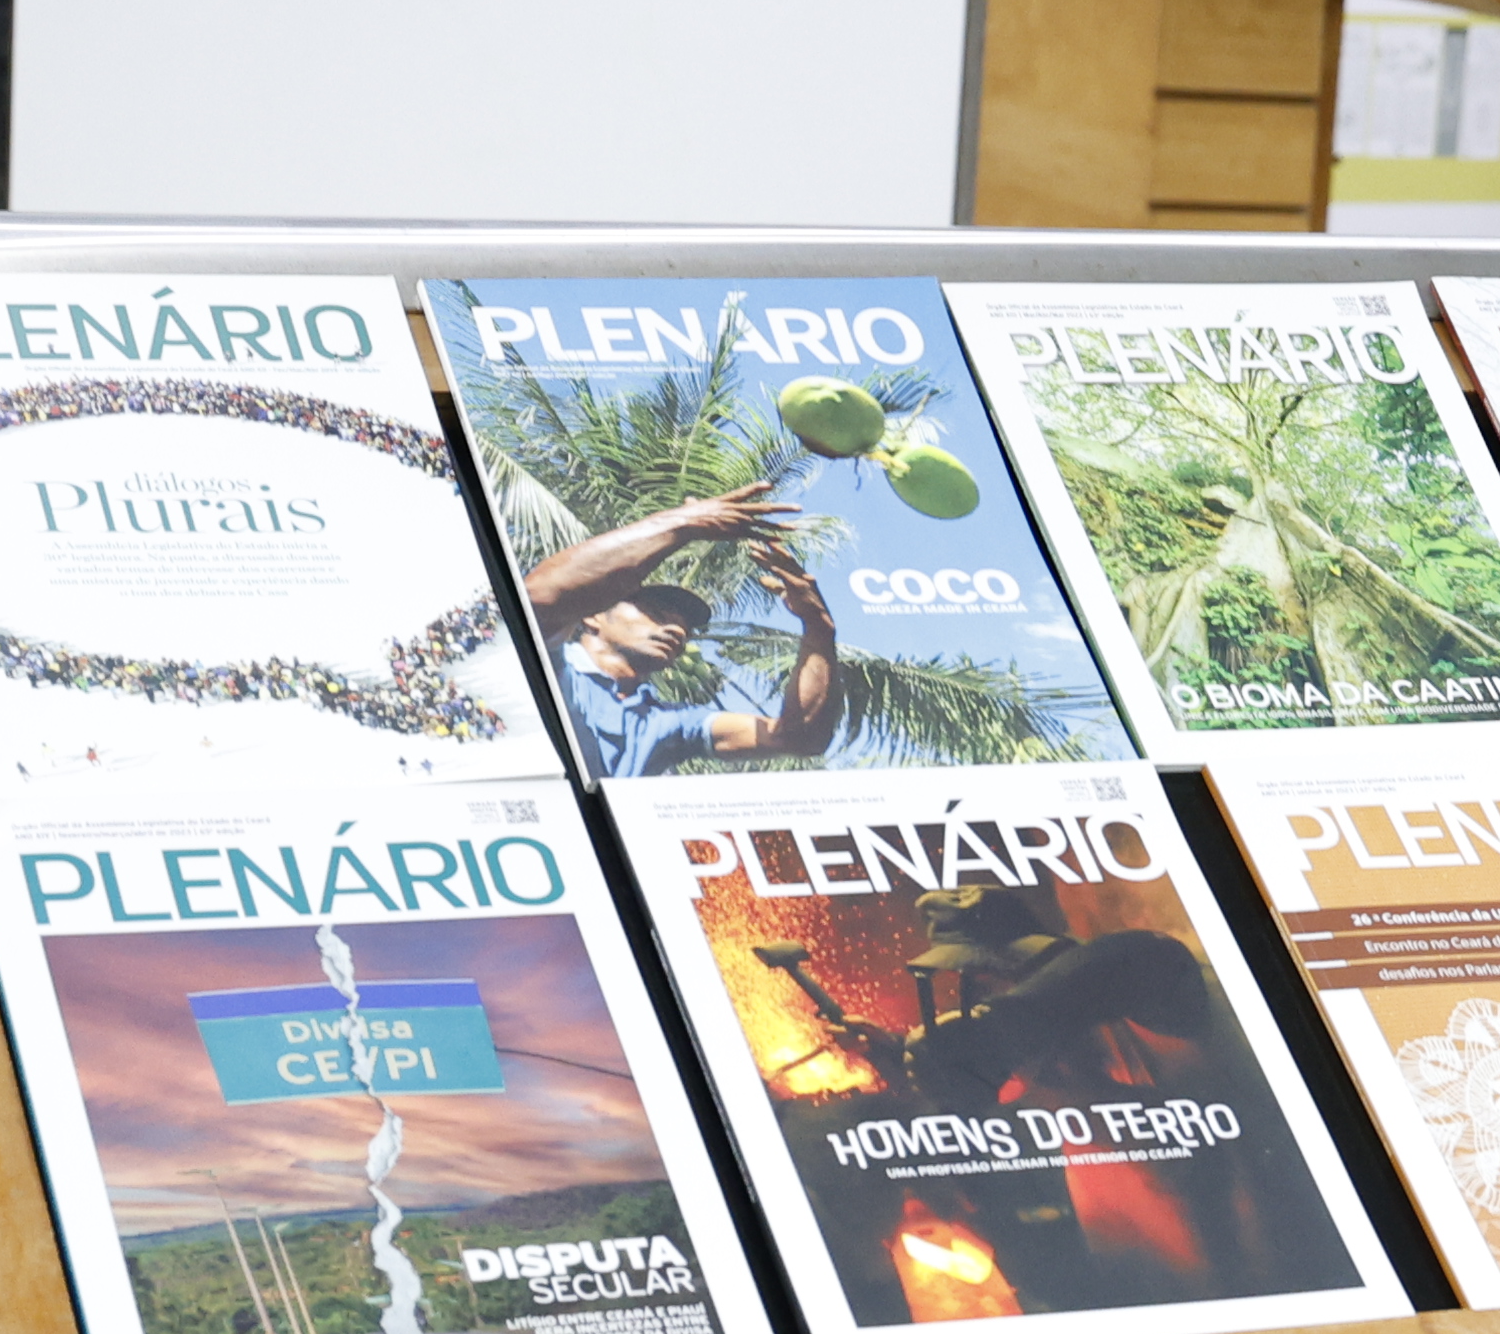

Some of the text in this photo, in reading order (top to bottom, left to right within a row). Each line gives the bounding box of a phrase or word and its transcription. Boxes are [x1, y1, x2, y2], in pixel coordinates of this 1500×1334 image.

[470, 291, 925, 366] PLENÁRIO
[1008, 308, 1420, 385] PLENÁRIO
[124, 472, 251, 497] diálogos
[24, 479, 326, 534] Plurais
[848, 567, 1021, 604] COCO
[861, 600, 1029, 616] RIQUEZA MADE IN CEARÁ
[1170, 684, 1202, 710] O
[1205, 681, 1332, 709] BIOMA
[1330, 679, 1390, 707] DA
[680, 799, 1170, 899] PLENÁRIO
[19, 821, 566, 926] PLENÁRIO
[1352, 913, 1373, 927] 26
[1382, 909, 1471, 925] Conferência
[1471, 908, 1491, 922] da
[1364, 939, 1430, 954] Encontro
[1430, 938, 1450, 951] no
[1450, 934, 1492, 950] Ceará
[1378, 966, 1437, 981] desafios
[1438, 966, 1466, 978] nos
[281, 1017, 414, 1044] Divisa
[276, 1045, 438, 1085] CE/PI
[827, 1098, 1242, 1170] HOMENS DO FERRO
[886, 1146, 1193, 1179] UMA PROFISSÃO MILENAR NO INTERIOR DO CEARÁ
[462, 1235, 688, 1283] DISPUTA
[528, 1267, 695, 1305] SECULAR
[506, 1300, 707, 1331] LITÍGIO ENTRE CEARÁ E PIAUÍ
